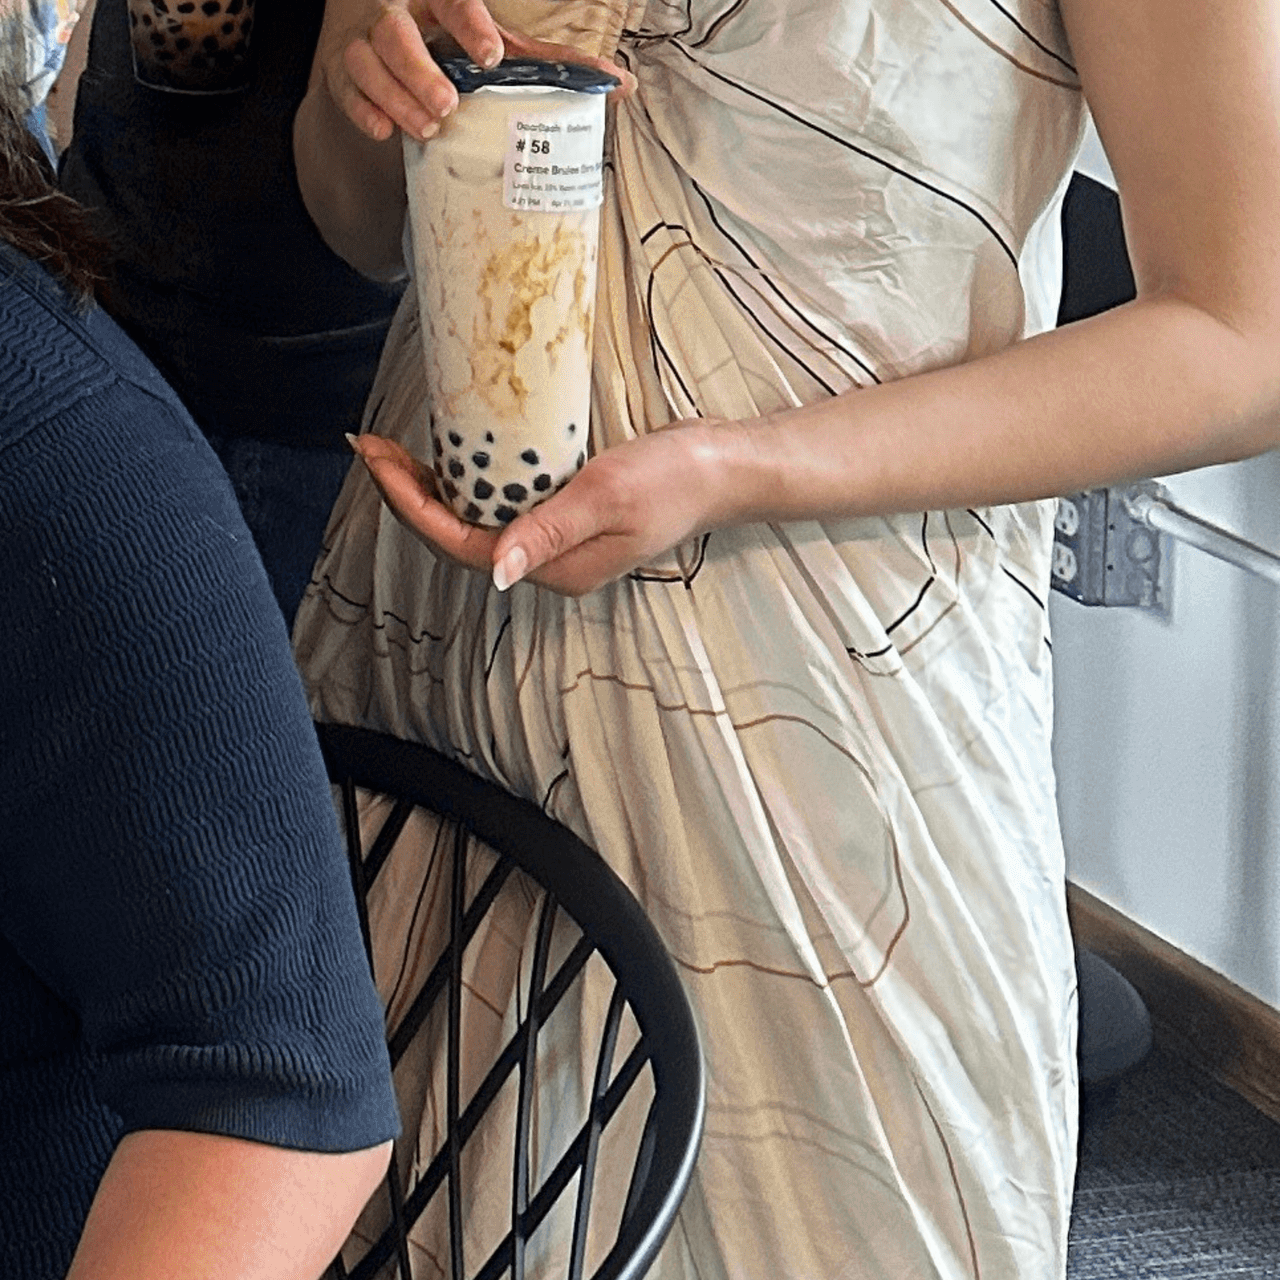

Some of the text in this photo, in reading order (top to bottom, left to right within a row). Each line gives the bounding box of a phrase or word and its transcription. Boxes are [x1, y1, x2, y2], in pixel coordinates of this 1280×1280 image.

[515, 139, 550, 155] # 58
[513, 162, 550, 175] Creme
